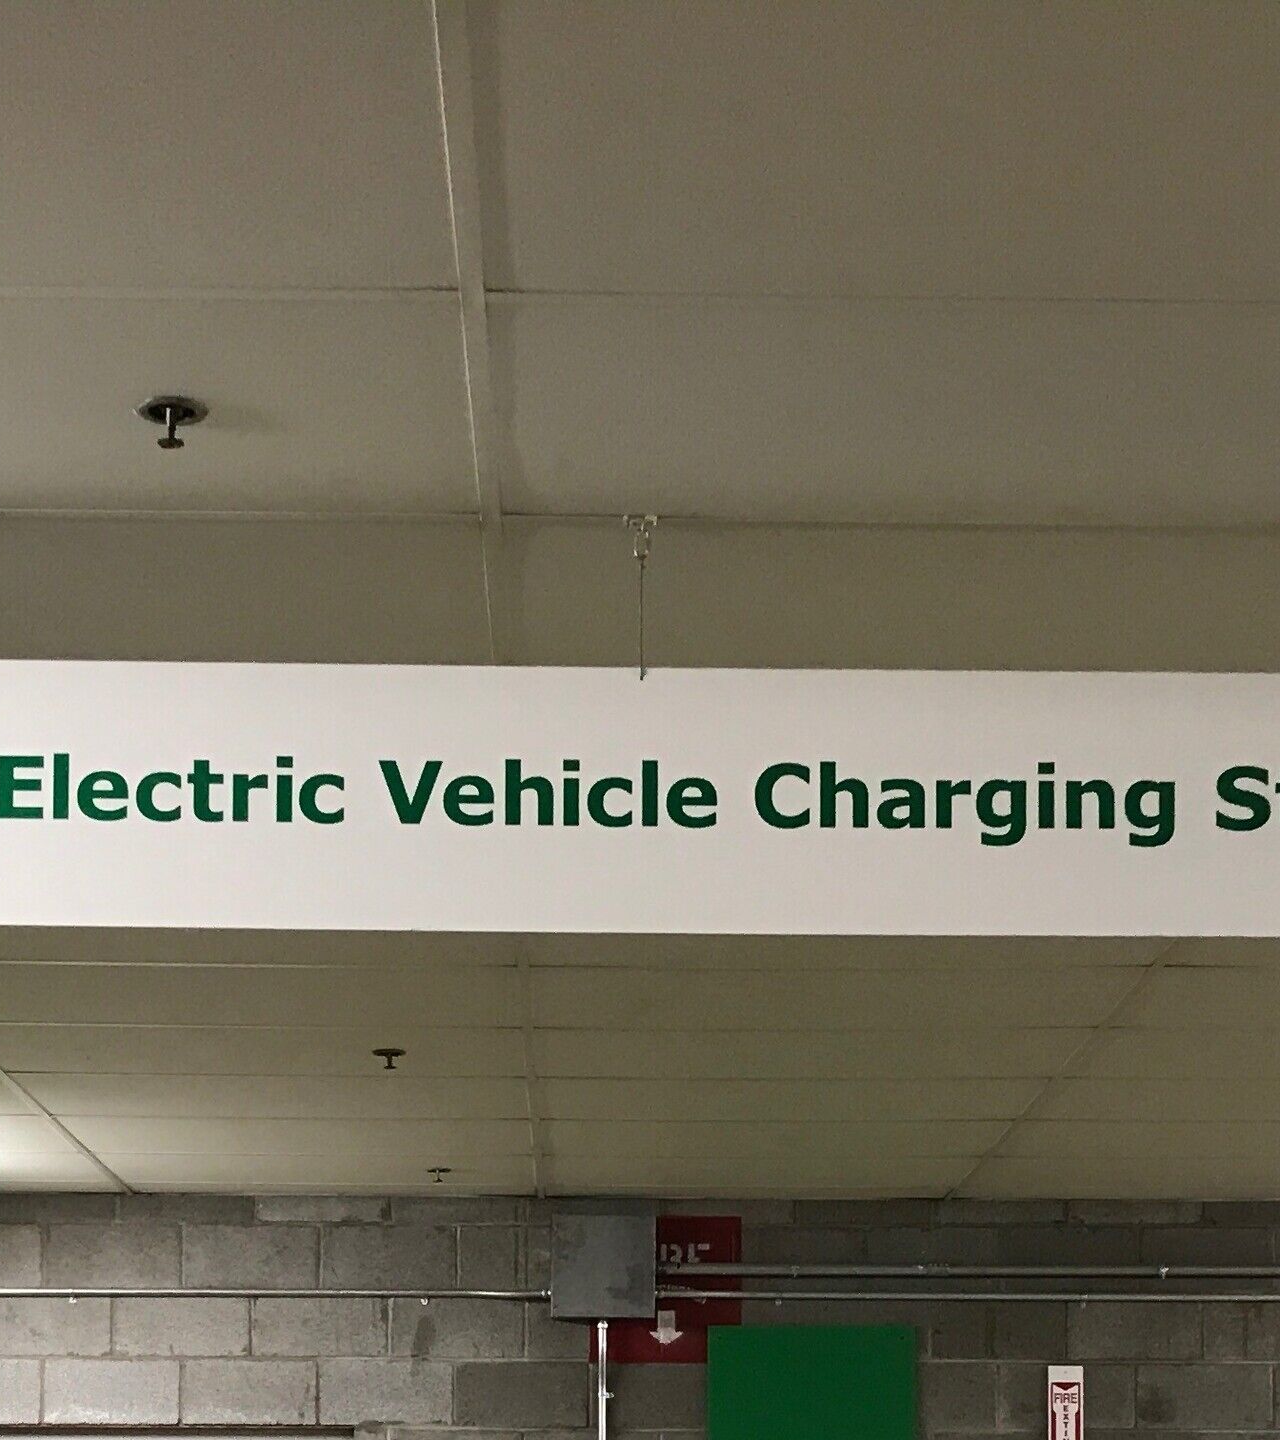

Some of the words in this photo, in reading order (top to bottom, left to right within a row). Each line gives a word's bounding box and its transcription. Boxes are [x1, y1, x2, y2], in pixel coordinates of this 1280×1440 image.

[379, 758, 718, 828] Vehicle
[753, 761, 1177, 847] Charging
[1053, 1392, 1078, 1404] FIRE
